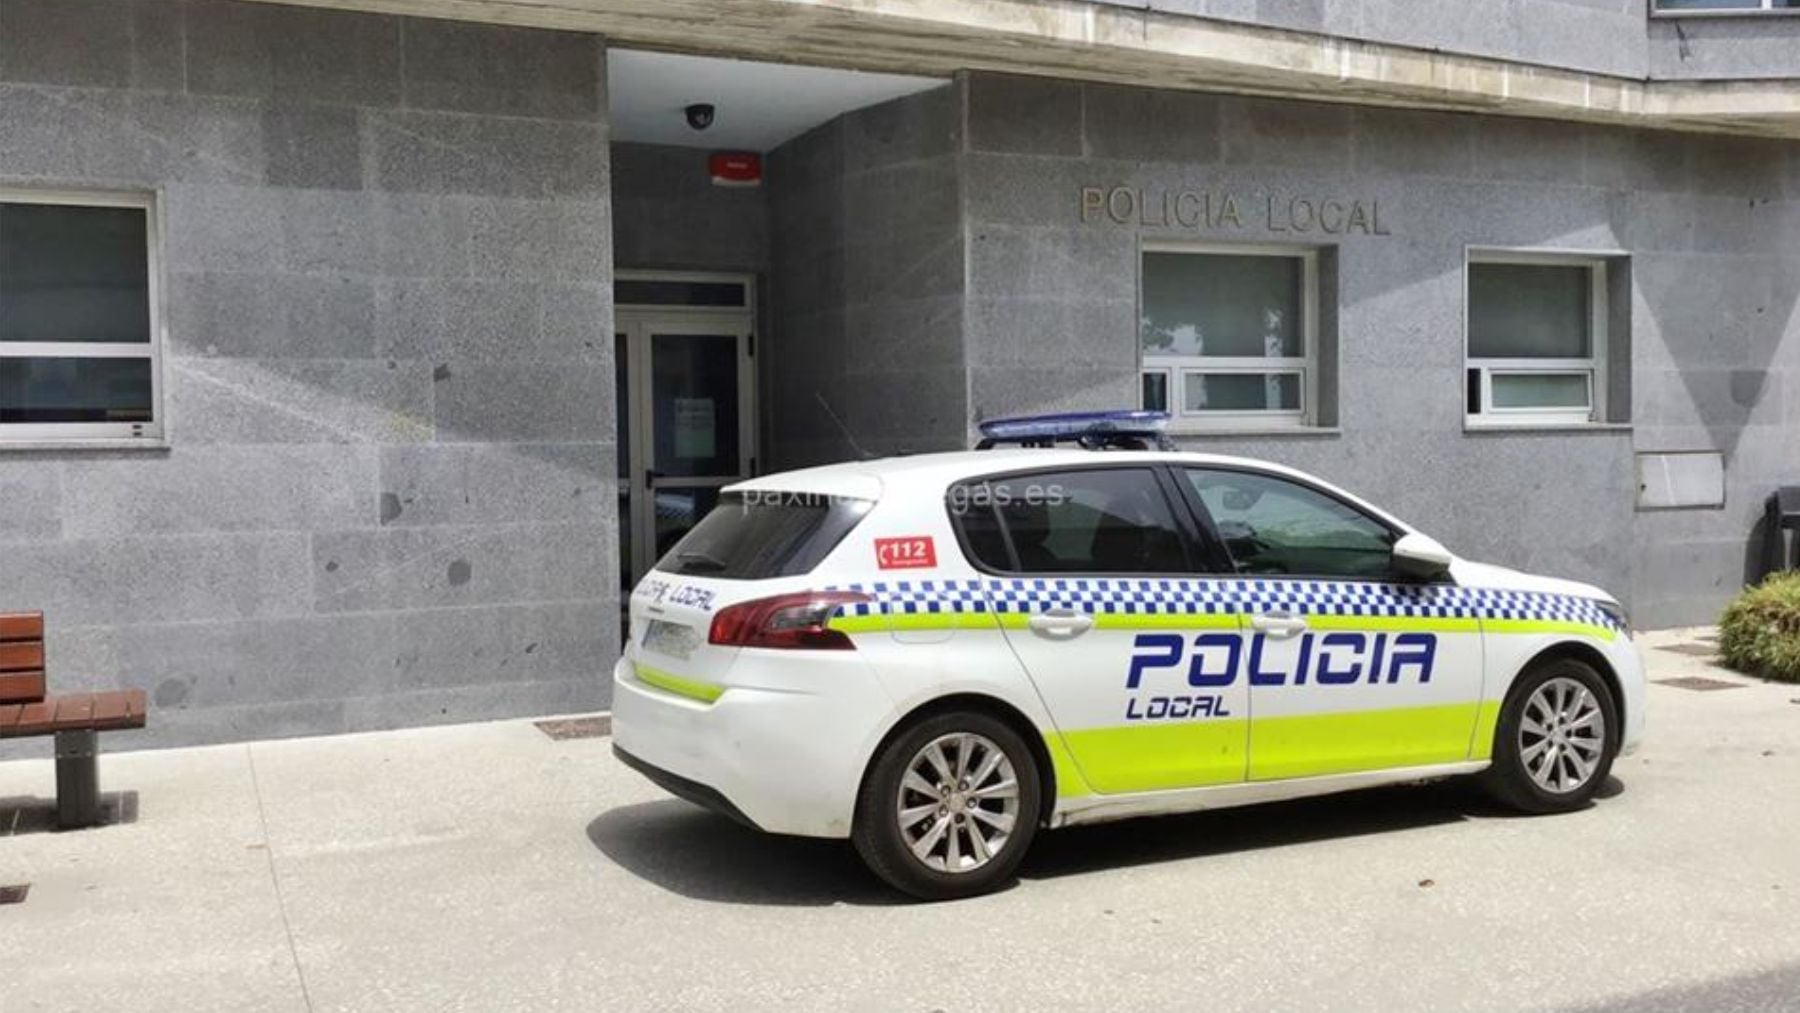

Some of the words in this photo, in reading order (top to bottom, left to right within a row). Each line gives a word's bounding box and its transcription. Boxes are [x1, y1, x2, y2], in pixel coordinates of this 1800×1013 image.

[1080, 186, 1242, 228] POLICIA
[1267, 196, 1391, 236] LOCAL
[889, 541, 926, 558] 112
[1126, 633, 1437, 688] POLICIA
[1126, 695, 1230, 719] LOCAL
